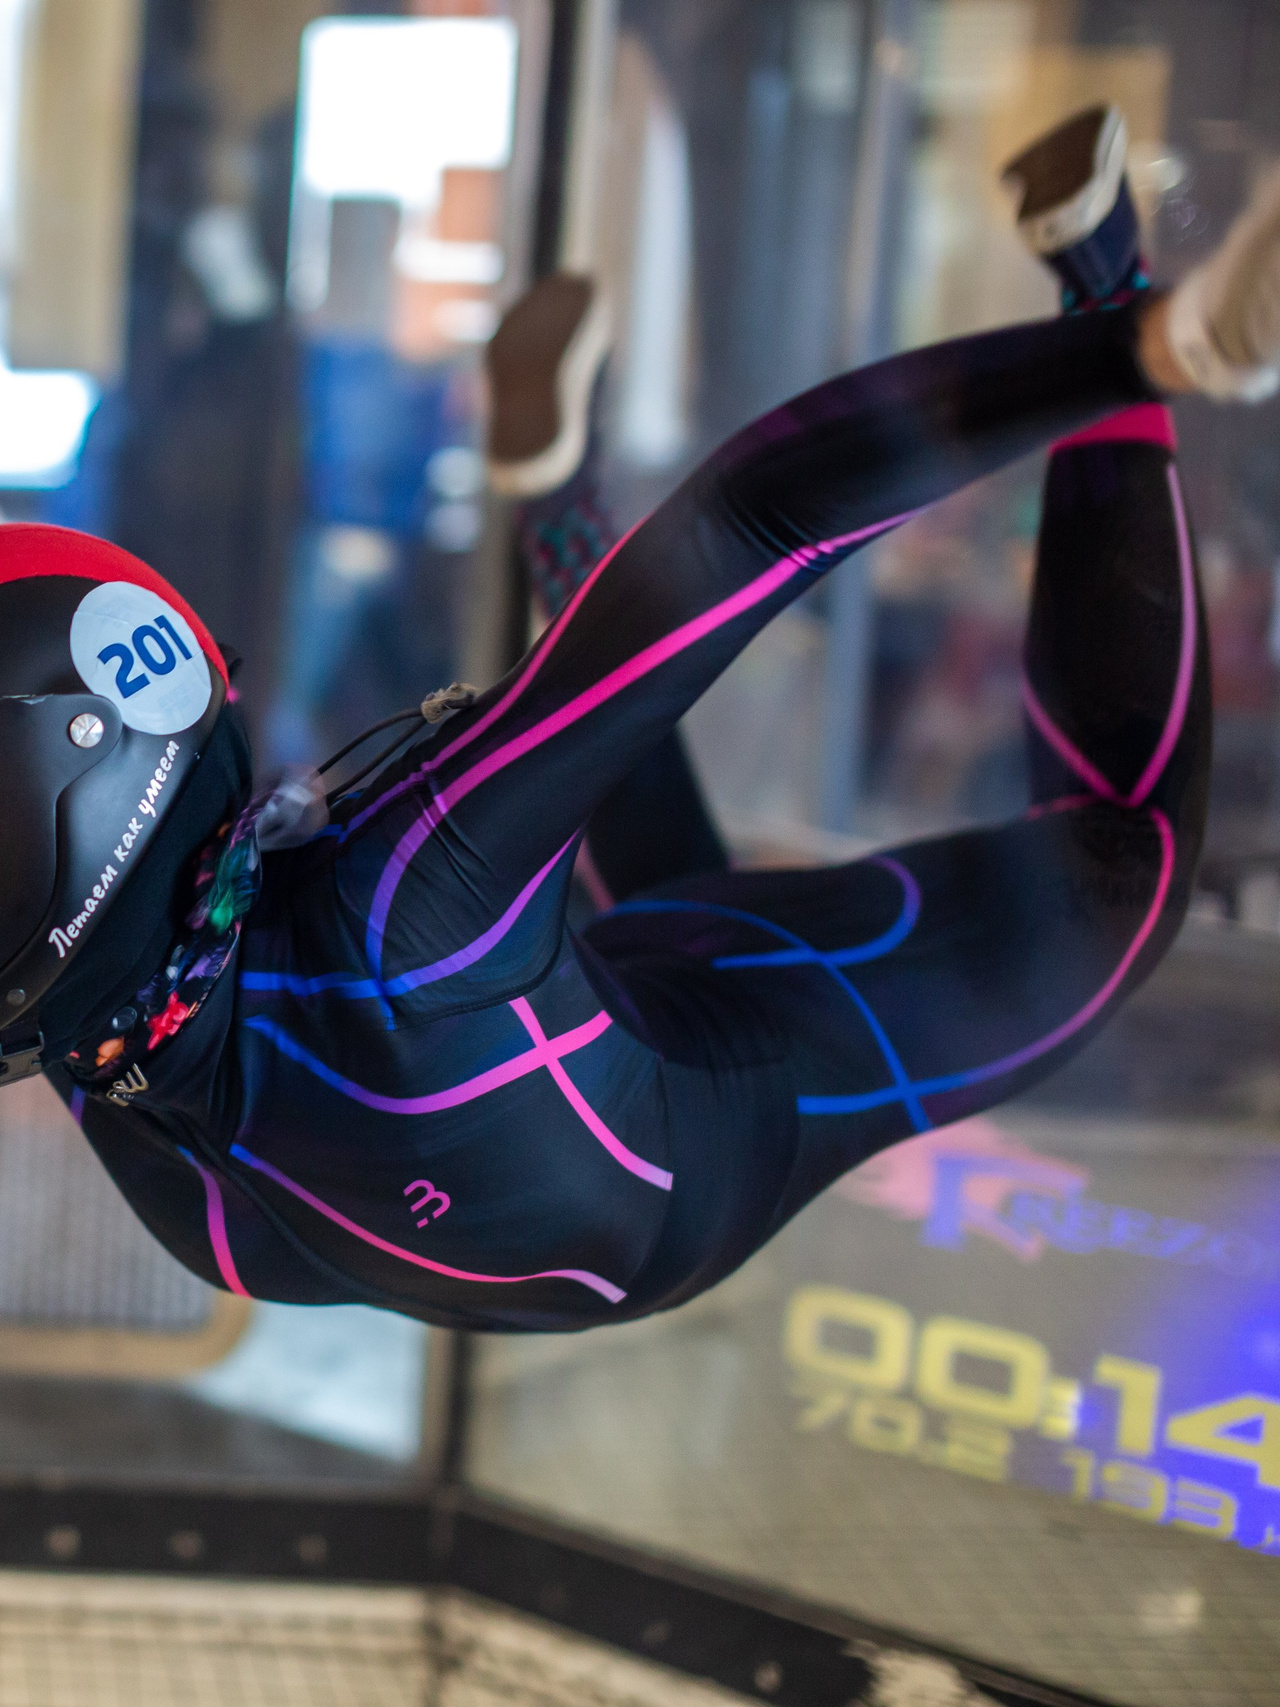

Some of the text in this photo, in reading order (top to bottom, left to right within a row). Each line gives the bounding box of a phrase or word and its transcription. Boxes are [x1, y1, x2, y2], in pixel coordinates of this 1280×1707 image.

[96, 613, 194, 699] 201
[48, 739, 181, 958] Летаем как умеем
[784, 1284, 1280, 1490] 00:14
